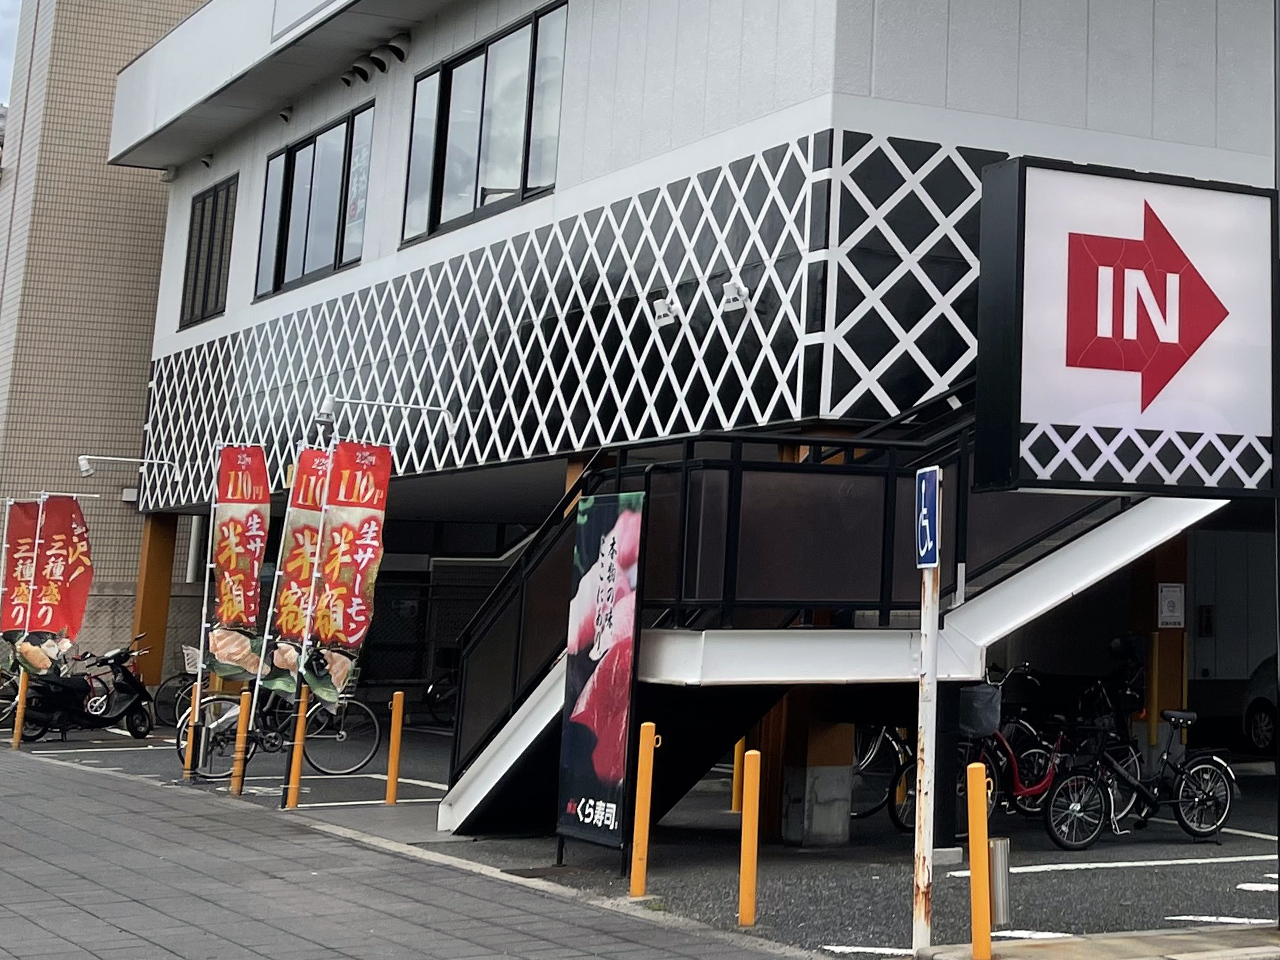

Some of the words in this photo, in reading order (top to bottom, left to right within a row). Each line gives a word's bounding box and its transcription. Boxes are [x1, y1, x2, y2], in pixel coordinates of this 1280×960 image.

[1097, 266, 1181, 344] IN
[346, 520, 380, 643] 生サーモン
[577, 797, 617, 830] くら寿司
